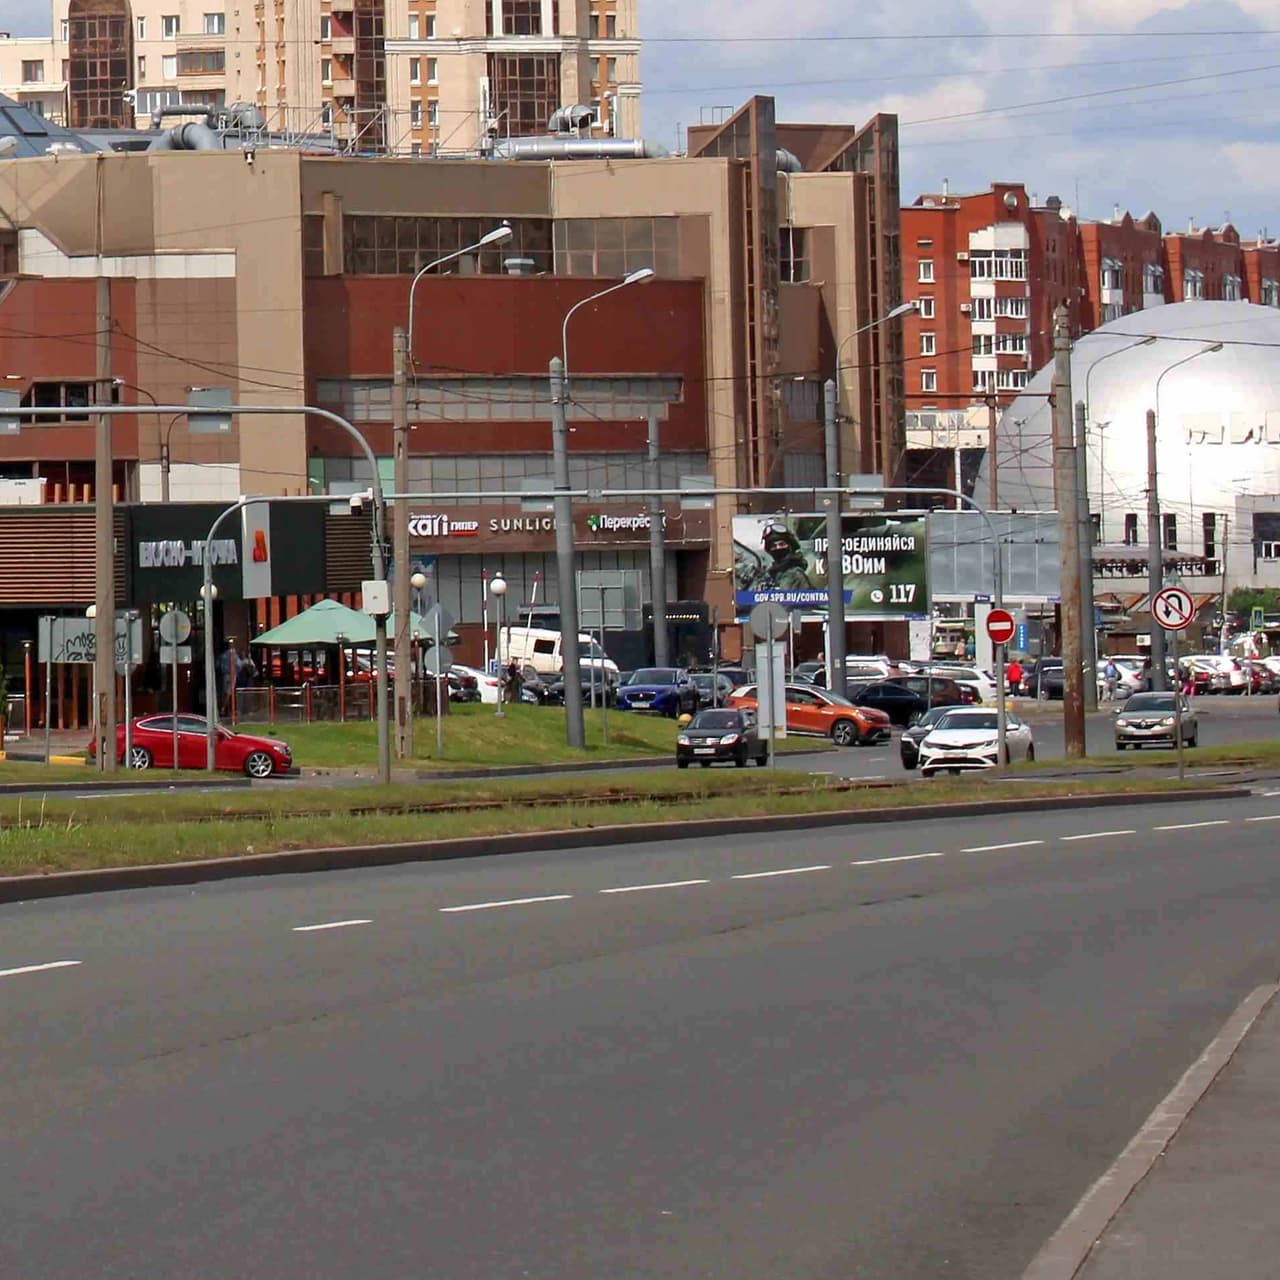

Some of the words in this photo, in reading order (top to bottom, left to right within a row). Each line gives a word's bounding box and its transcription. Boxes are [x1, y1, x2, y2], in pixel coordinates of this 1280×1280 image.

[489, 517, 558, 531] SUNLIG
[815, 534, 915, 553] ПРОЕДИНЯЙСЯ
[842, 553, 886, 574] ВОим
[754, 592, 829, 603] GOV.SPB.RU/CONTRA
[889, 583, 916, 603] 117
